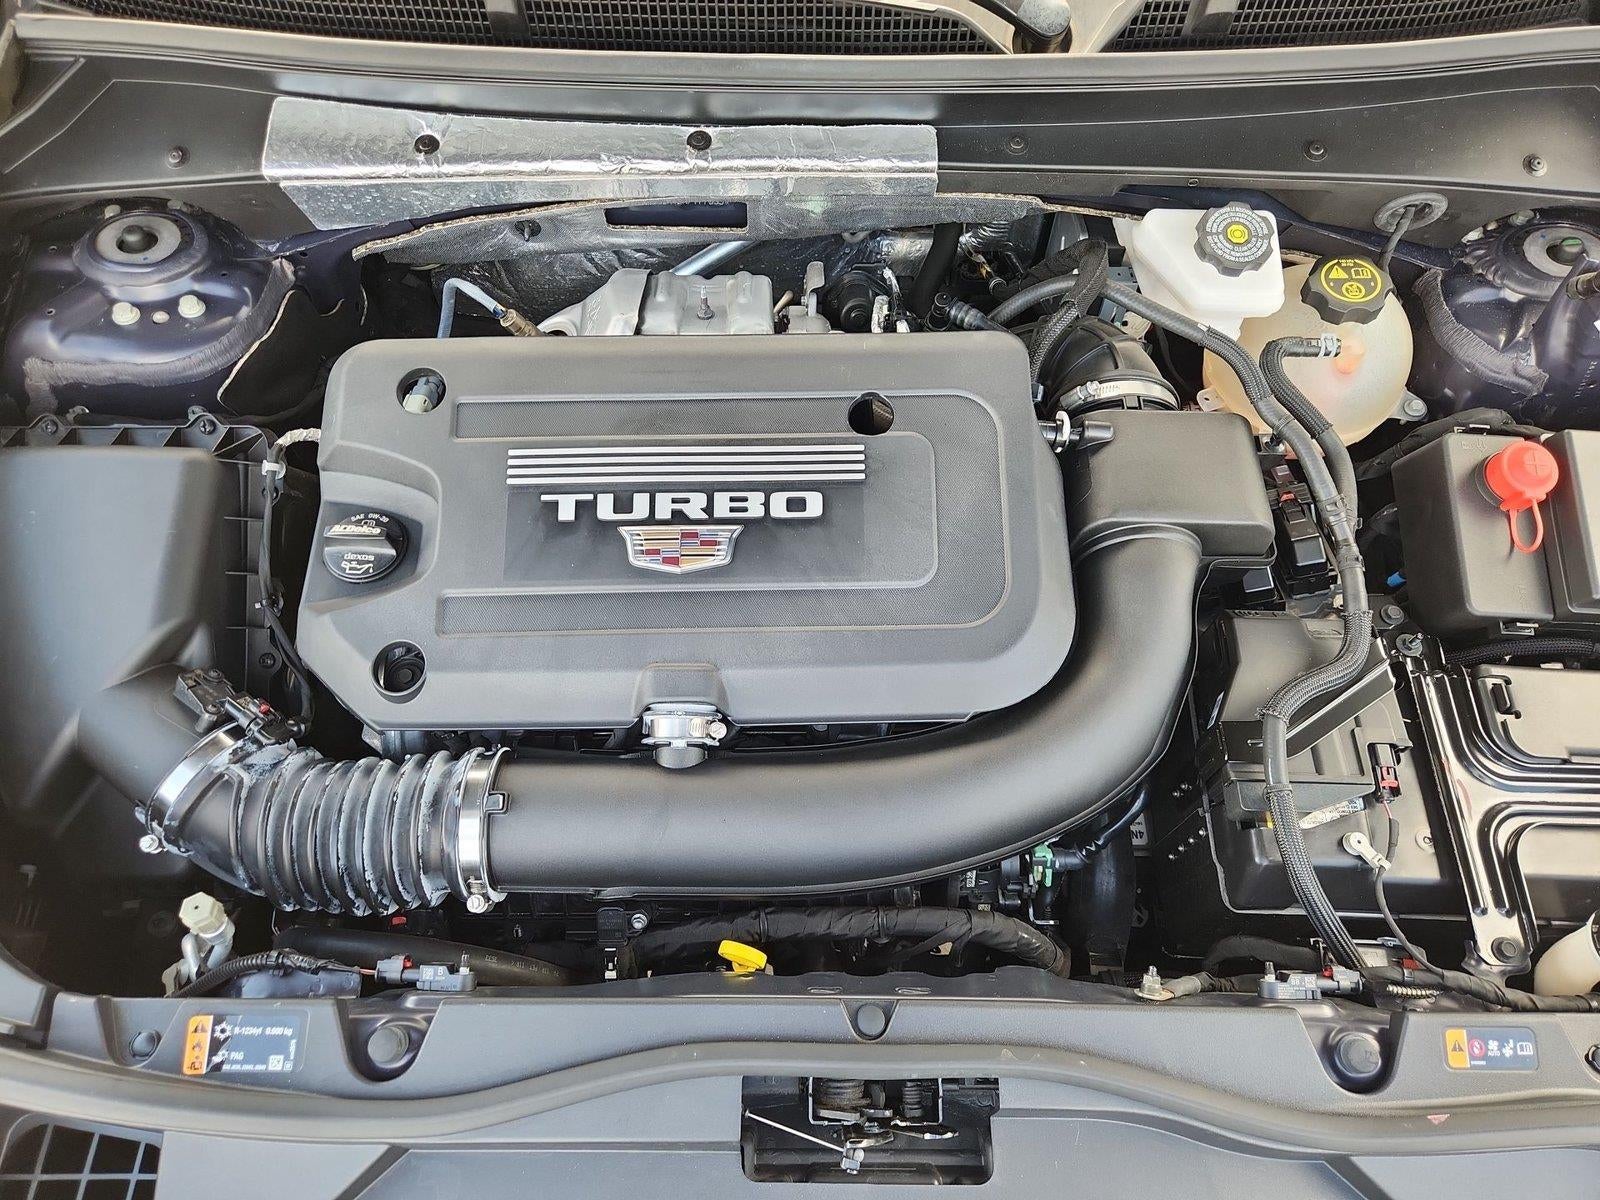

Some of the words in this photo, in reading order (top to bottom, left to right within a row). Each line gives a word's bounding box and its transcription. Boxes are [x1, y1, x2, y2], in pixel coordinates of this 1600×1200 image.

[540, 490, 824, 523] TURBO
[351, 513, 365, 522] SAE
[368, 512, 390, 523] 0W-20
[330, 524, 381, 534] ACDelco
[344, 552, 375, 561] dexos
